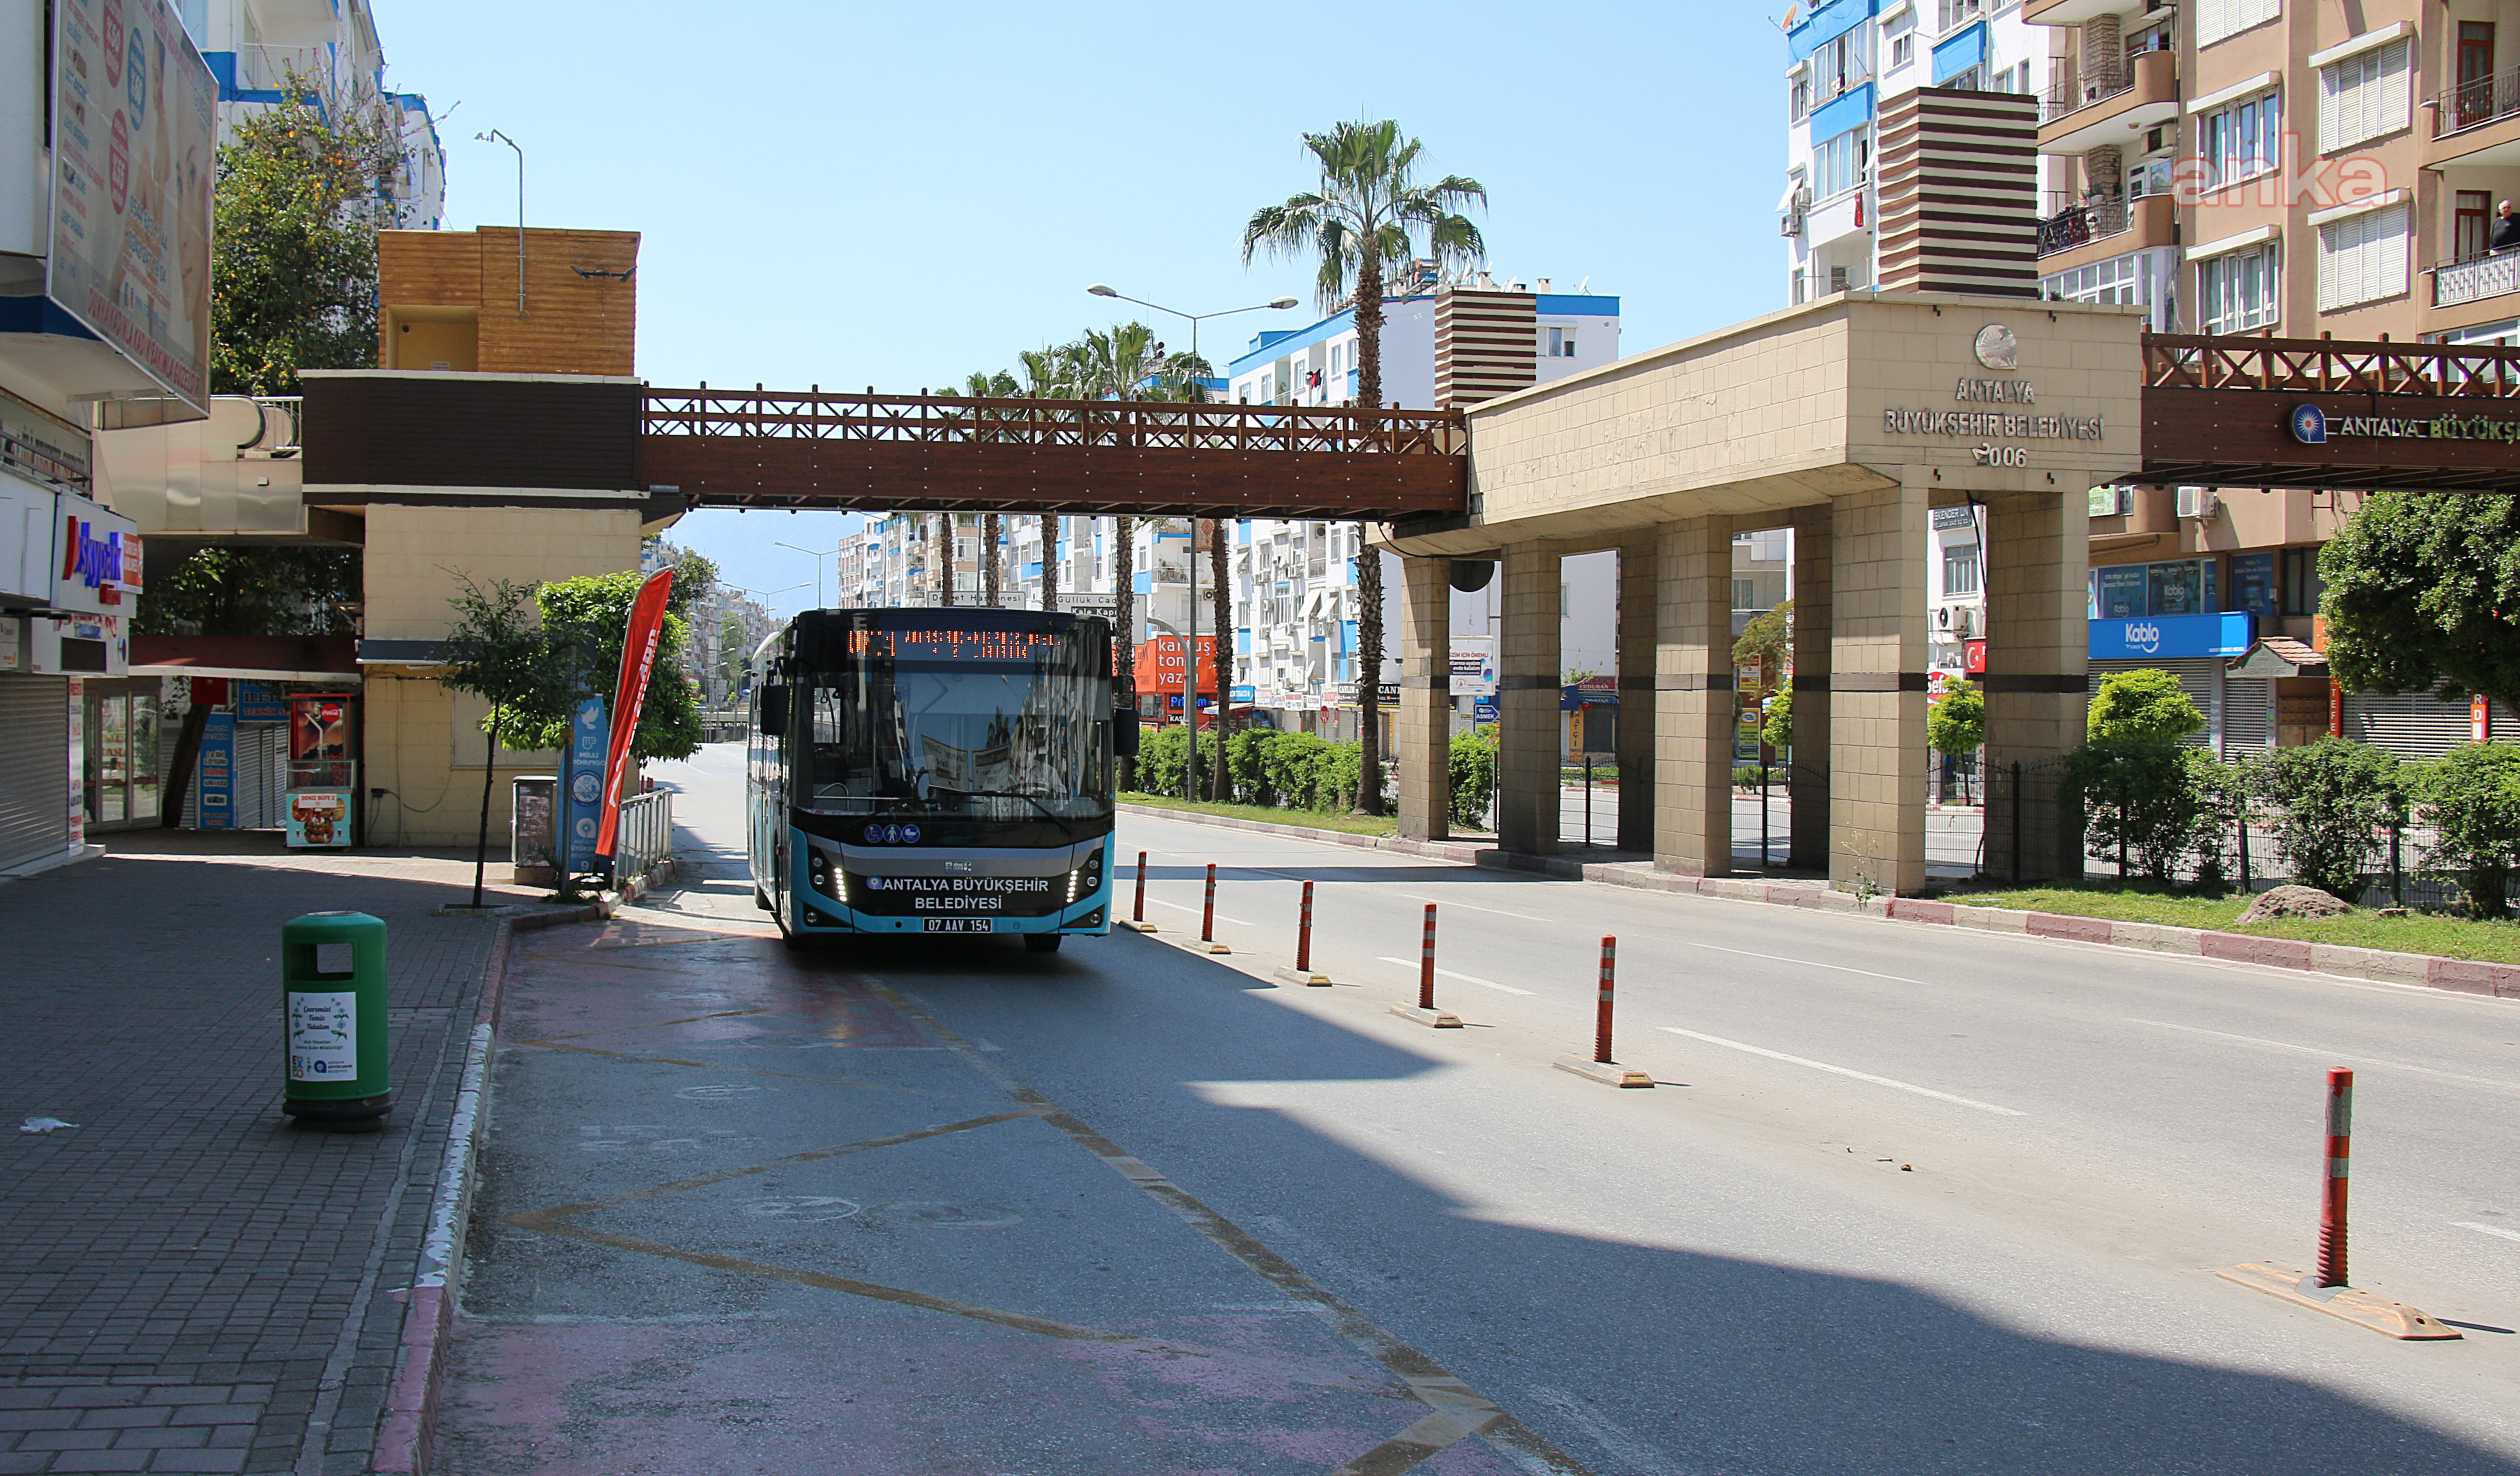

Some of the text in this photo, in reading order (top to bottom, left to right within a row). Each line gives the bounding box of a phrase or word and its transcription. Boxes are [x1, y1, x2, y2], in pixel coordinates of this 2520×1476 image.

[1956, 378, 2034, 404] ANTALYA
[1884, 408, 2104, 440] BÜYÜKŞEHİR BELEDİYESİ
[2340, 416, 2419, 438] ANTALYA
[1972, 442, 2028, 468] 2006
[2164, 584, 2184, 596] Kablo
[970, 594, 1020, 602] Hasnesi
[1058, 596, 1139, 604] Güllük Cadsi
[1096, 608, 1117, 617] Kapı
[2126, 622, 2160, 643] Kablo
[1158, 638, 1210, 656] karuş
[1158, 656, 1202, 666] tonr
[1158, 672, 1198, 684] yazı
[244, 707, 277, 716] TEKNİK
[581, 860, 589, 870] 9
[945, 862, 972, 874] BMC
[883, 877, 1048, 894] ANTALYA BÜYÜKŞEHİR
[915, 895, 1002, 909] BELEDİYESİ
[929, 920, 988, 931] 07 AAV 154
